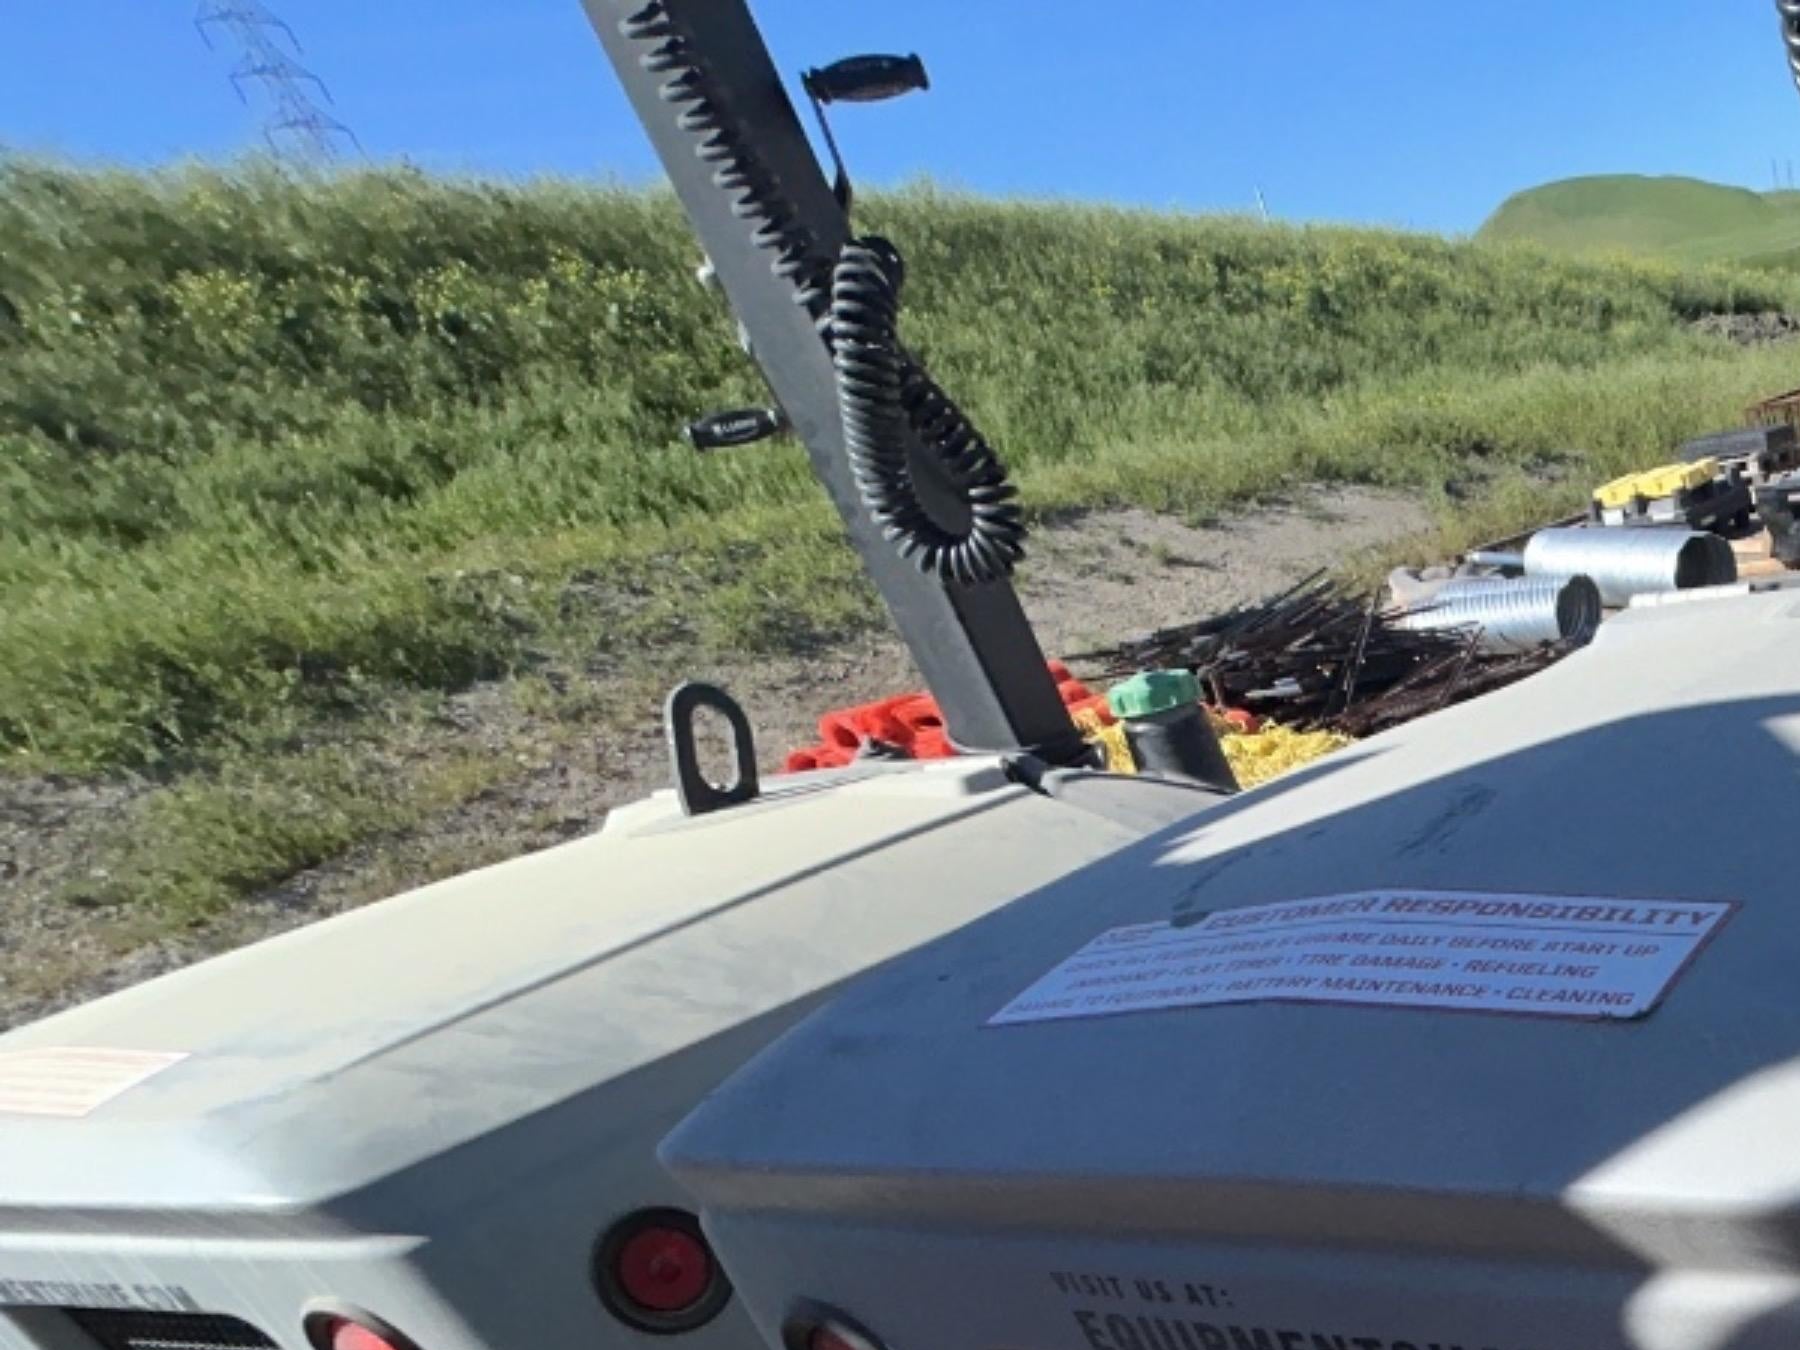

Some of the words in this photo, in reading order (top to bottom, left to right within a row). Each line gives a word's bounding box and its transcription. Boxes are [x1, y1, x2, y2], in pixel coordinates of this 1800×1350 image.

[1203, 896, 1380, 930] CUSTOMER
[1381, 896, 1714, 927] RESPONSIBILITY
[1378, 935, 1447, 947] DAILY
[1447, 935, 1536, 952] BEFORE
[1541, 940, 1619, 956] START
[1622, 944, 1662, 958] UP
[1350, 953, 1444, 970] DAMAGE
[1464, 958, 1600, 979] REFUELING
[1320, 977, 1491, 999] MAINTENANCE
[1505, 984, 1636, 1006] CLEANING
[1049, 1272, 1125, 1300] VISIT
[1132, 1278, 1175, 1303] US
[1183, 1283, 1235, 1308] AT:
